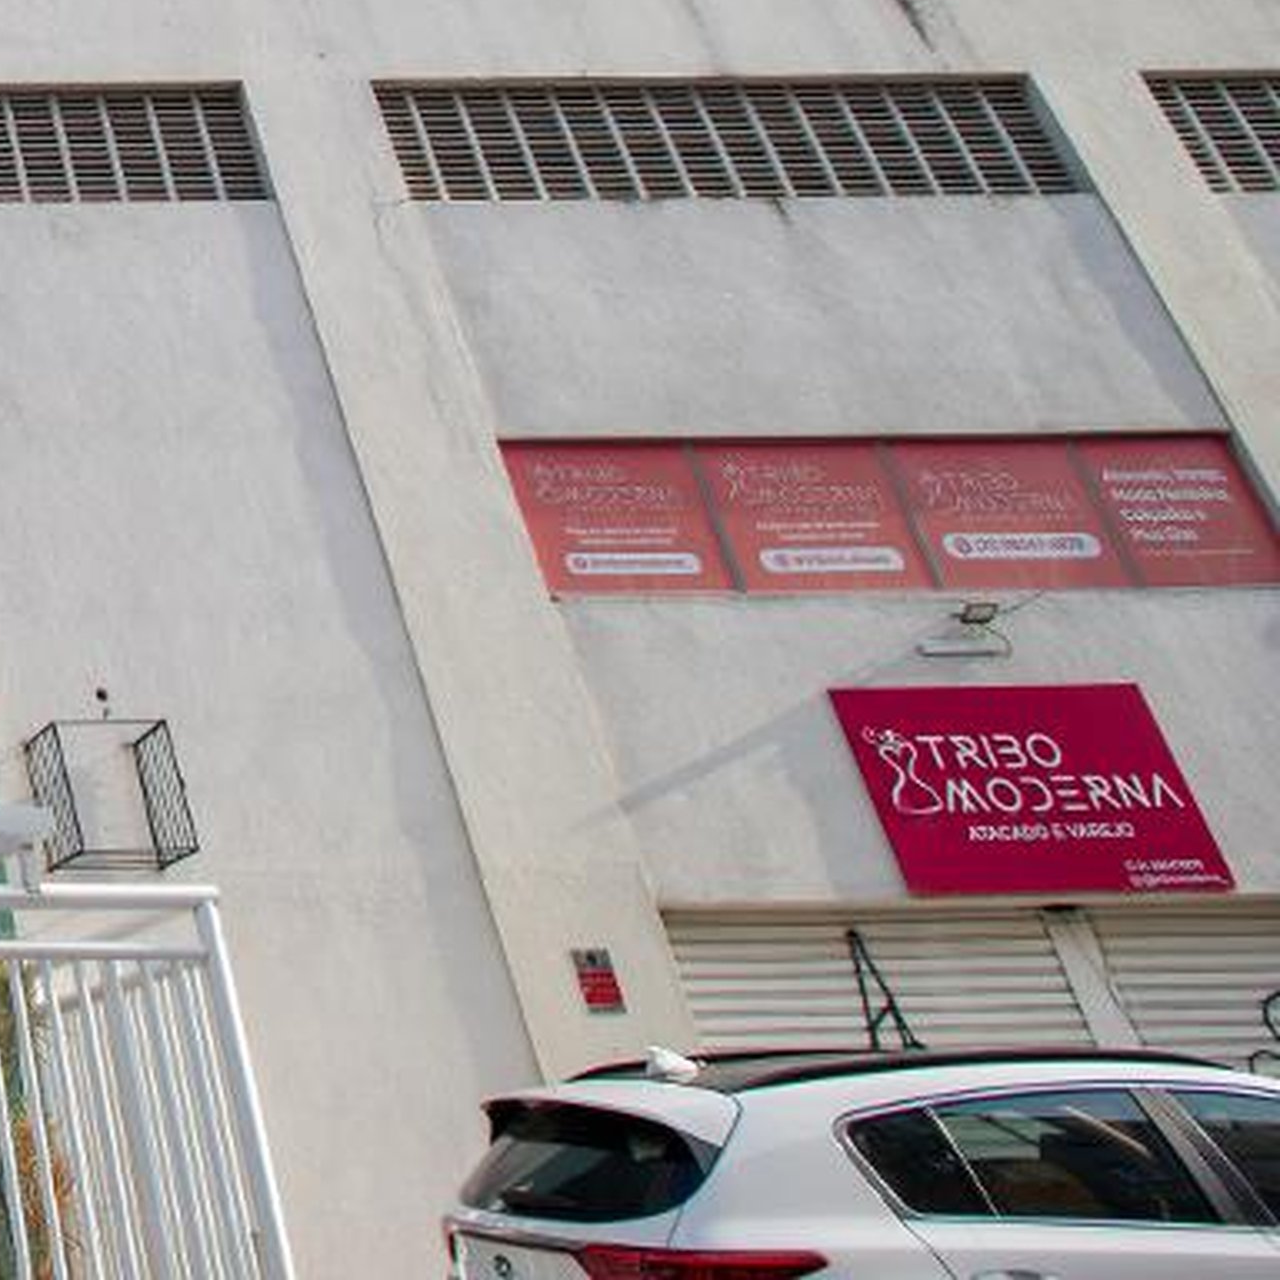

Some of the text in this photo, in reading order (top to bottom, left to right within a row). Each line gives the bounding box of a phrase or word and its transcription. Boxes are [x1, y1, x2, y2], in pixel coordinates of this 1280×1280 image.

[915, 733, 1062, 769] TRIBO
[946, 774, 1185, 813] MODERNA
[968, 825, 1047, 841] ATACADO
[1067, 822, 1135, 839] VAREJO
